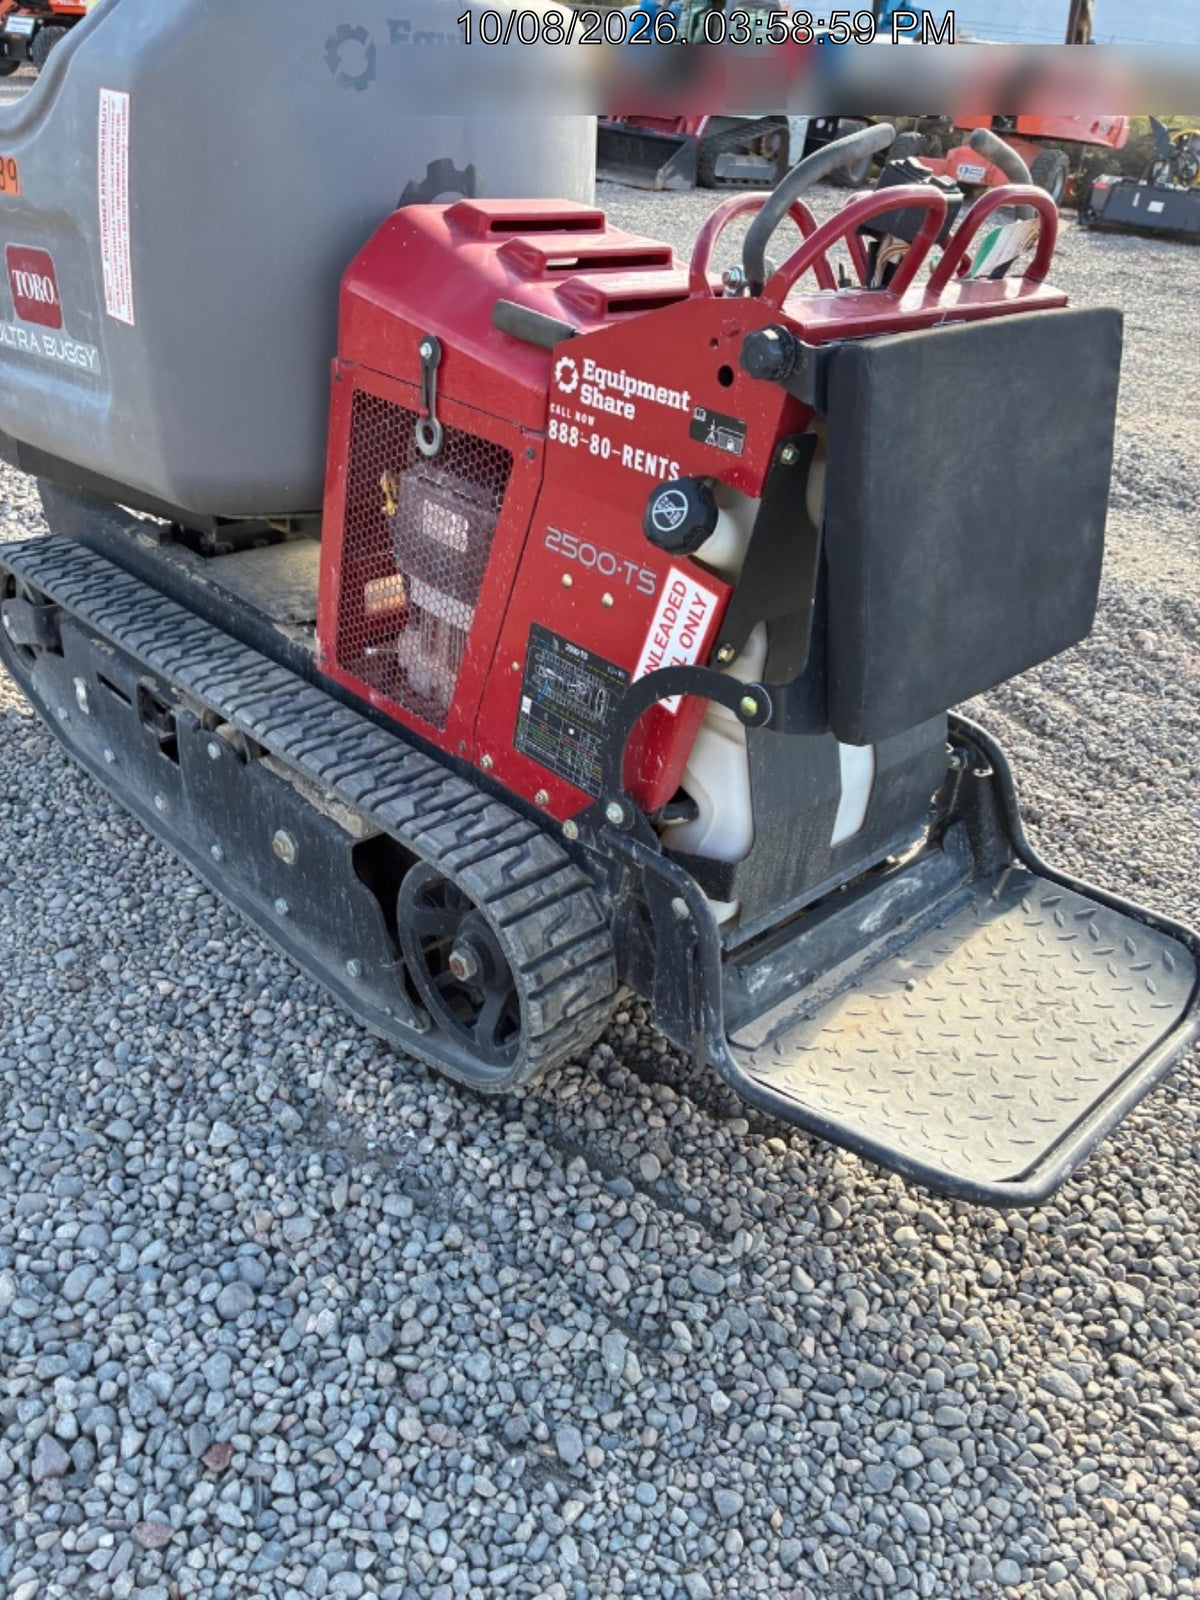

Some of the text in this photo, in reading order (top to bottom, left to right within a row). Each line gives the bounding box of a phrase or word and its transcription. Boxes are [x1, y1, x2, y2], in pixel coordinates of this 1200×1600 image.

[11, 269, 56, 305] TORO
[41, 334, 96, 369] BUGGY
[579, 383, 636, 421] Share
[581, 357, 692, 412] Equipment
[549, 402, 596, 427] CALL NOW
[548, 419, 680, 482] 888-80-RENTS
[643, 579, 688, 677] NLEADED
[678, 591, 709, 651] ONLY
